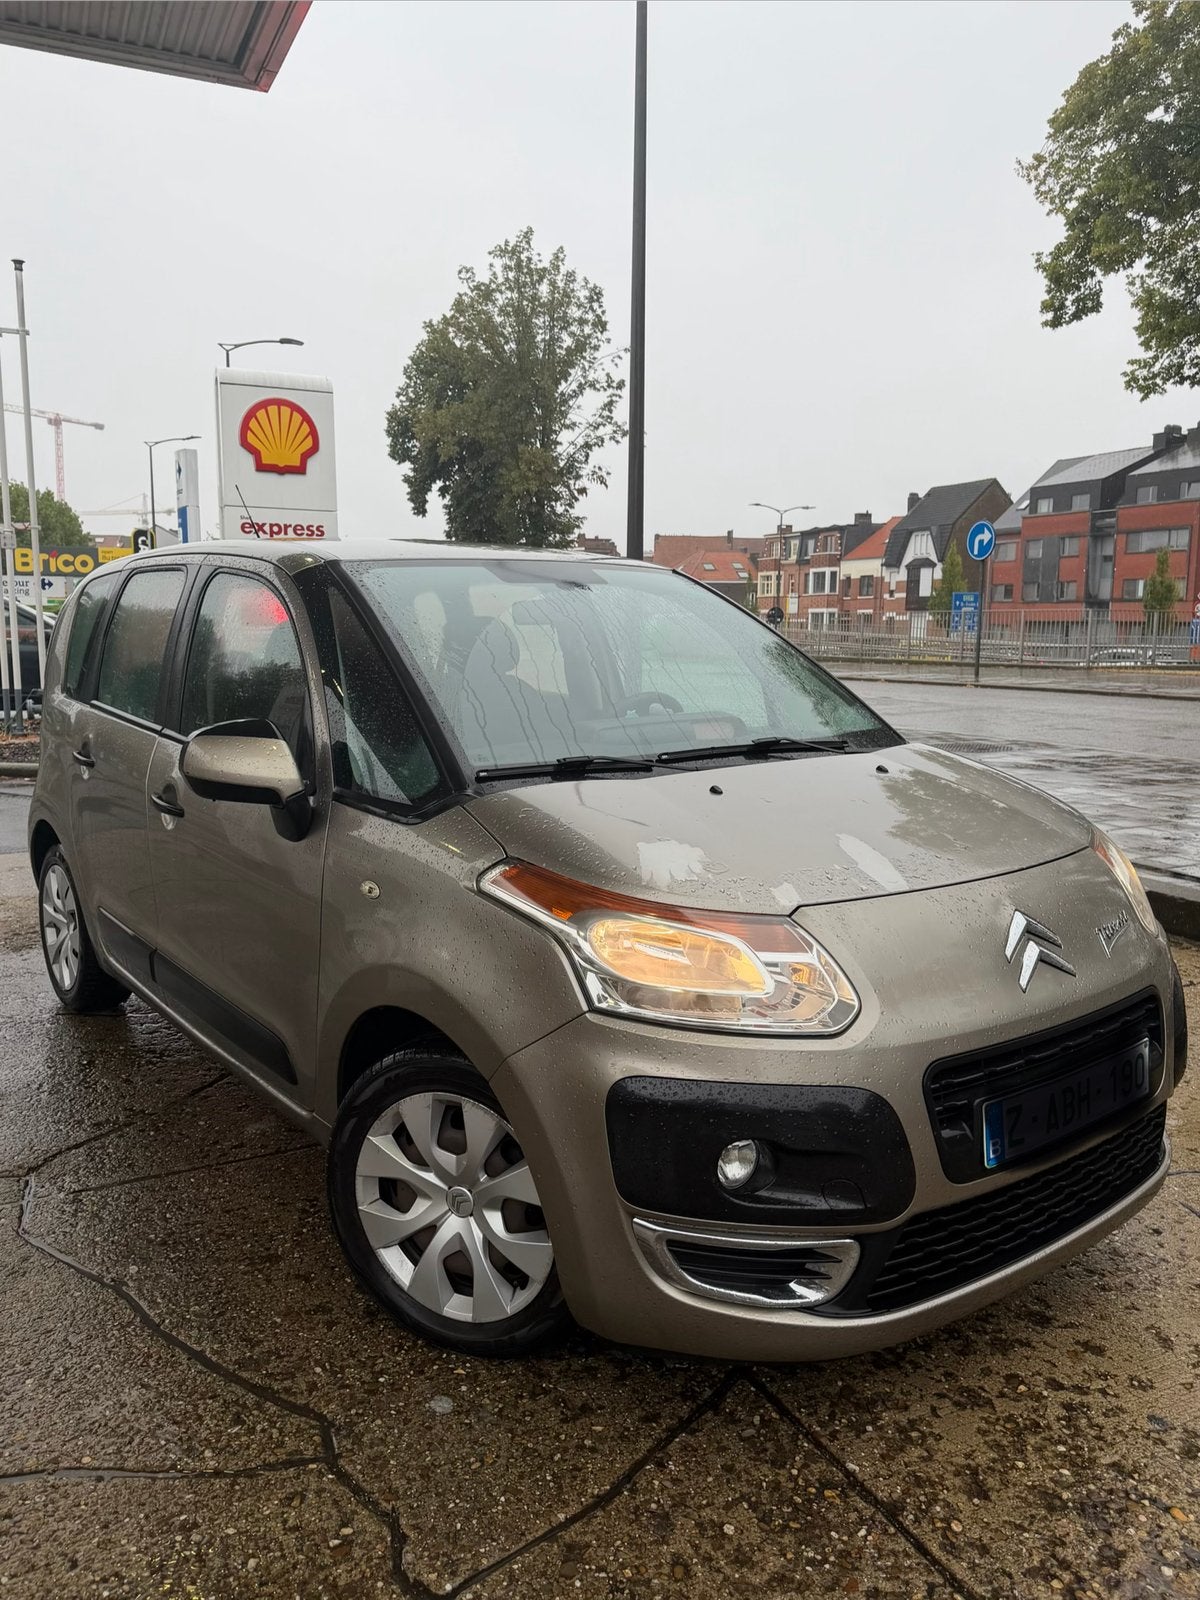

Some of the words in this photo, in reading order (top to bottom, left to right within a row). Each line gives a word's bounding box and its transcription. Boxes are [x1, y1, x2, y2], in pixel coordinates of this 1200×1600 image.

[240, 521, 325, 537] express
[14, 547, 94, 574] Brico
[989, 1138, 1001, 1159] B
